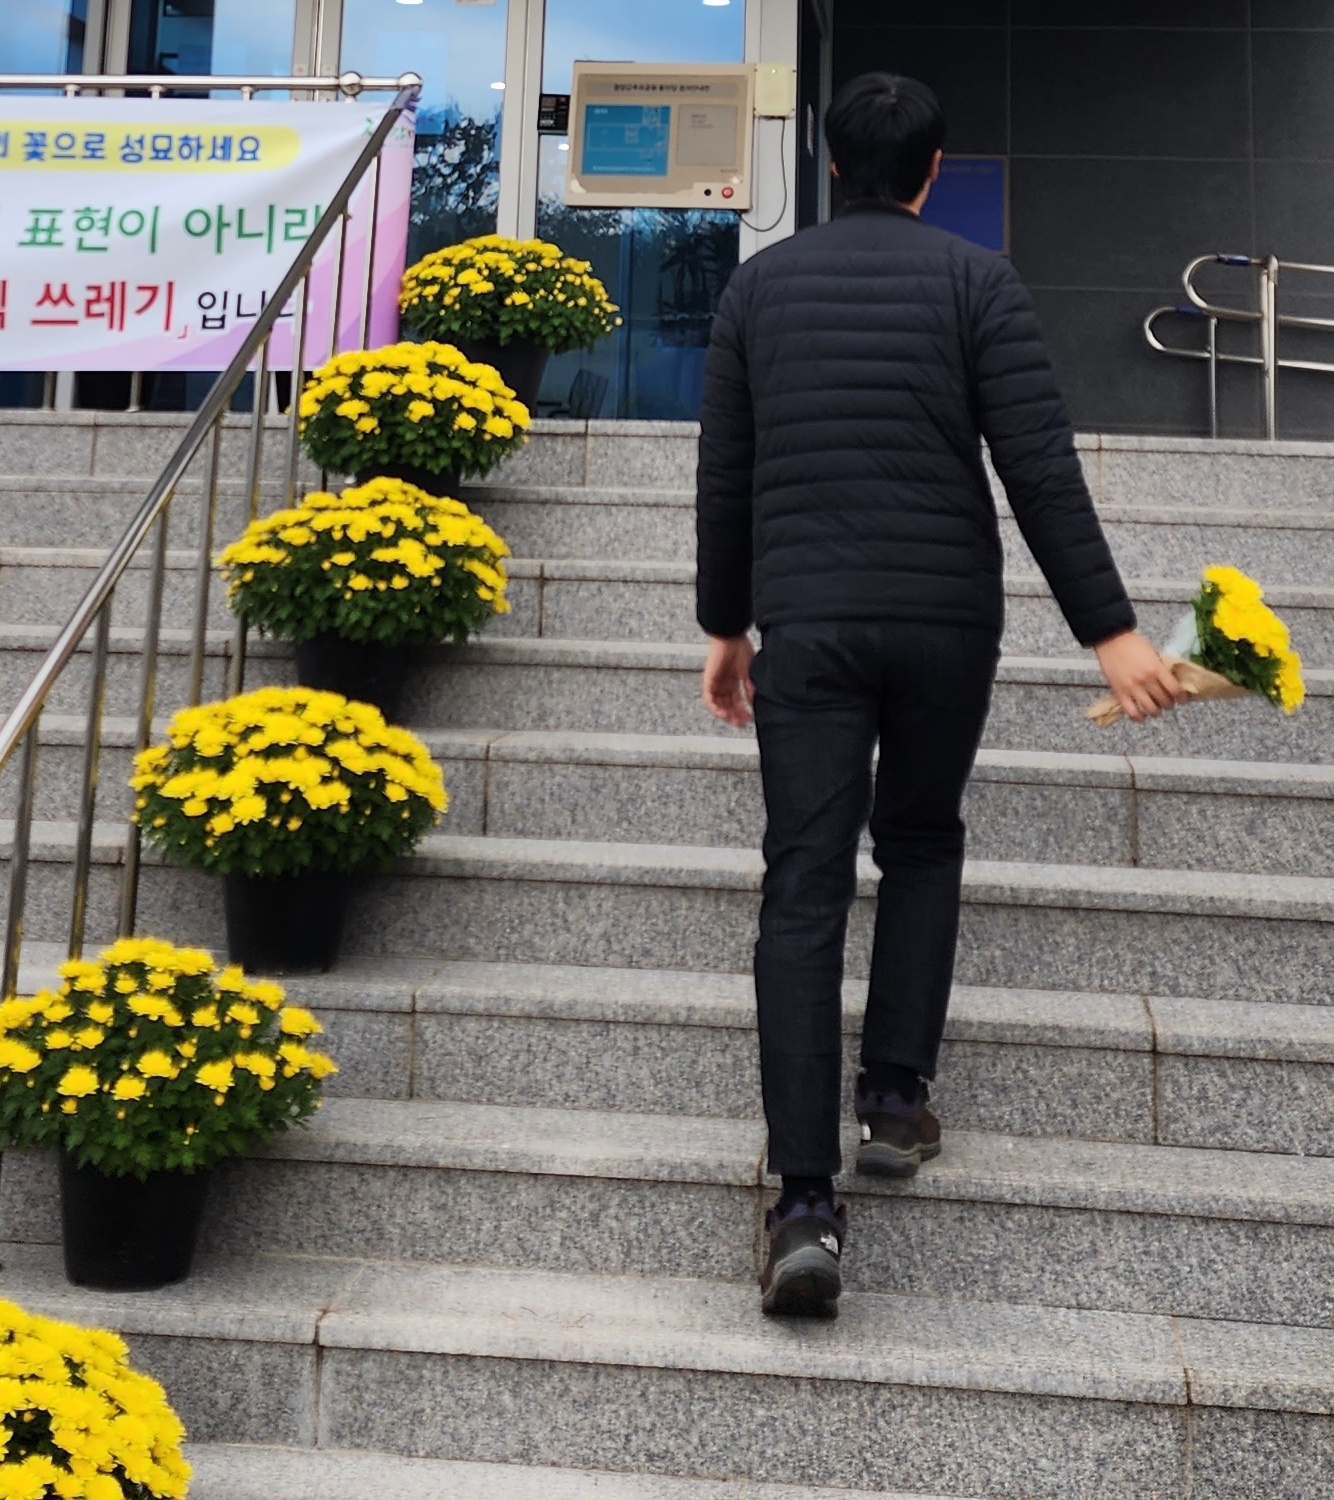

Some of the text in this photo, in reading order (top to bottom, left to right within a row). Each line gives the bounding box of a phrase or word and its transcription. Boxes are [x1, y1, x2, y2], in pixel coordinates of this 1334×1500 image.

[24, 132, 106, 161] 꽃으로
[120, 134, 260, 163] 성묘하세요
[17, 205, 160, 254] 표현이
